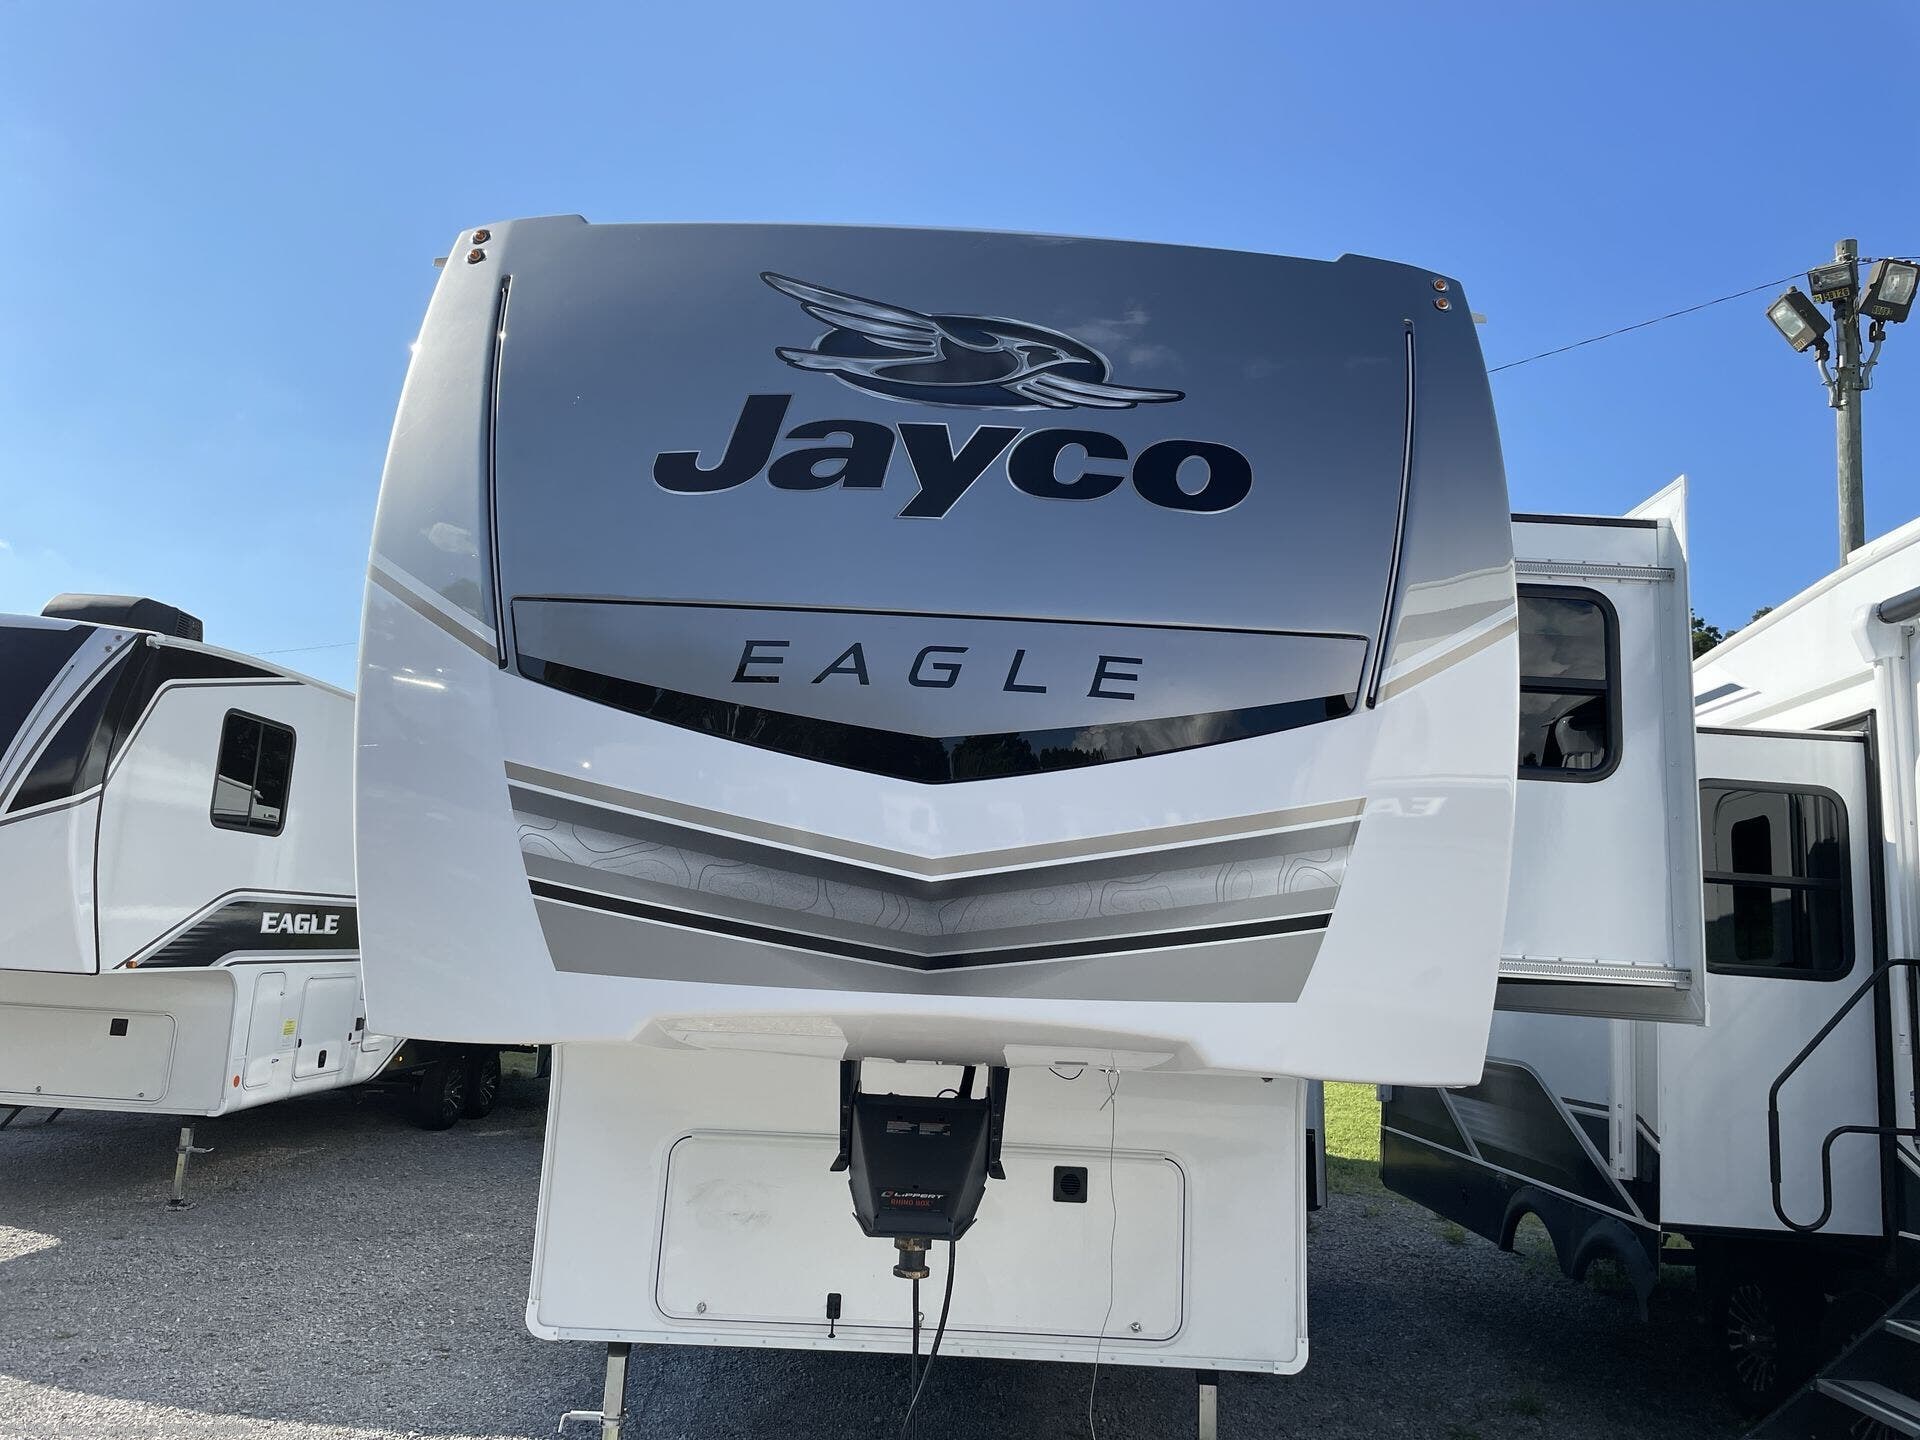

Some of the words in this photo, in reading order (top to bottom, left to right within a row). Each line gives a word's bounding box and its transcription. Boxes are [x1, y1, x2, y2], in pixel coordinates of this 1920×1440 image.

[651, 393, 1254, 520] Jayco
[731, 639, 1144, 700] EAGLE
[260, 911, 341, 935] EAGLE
